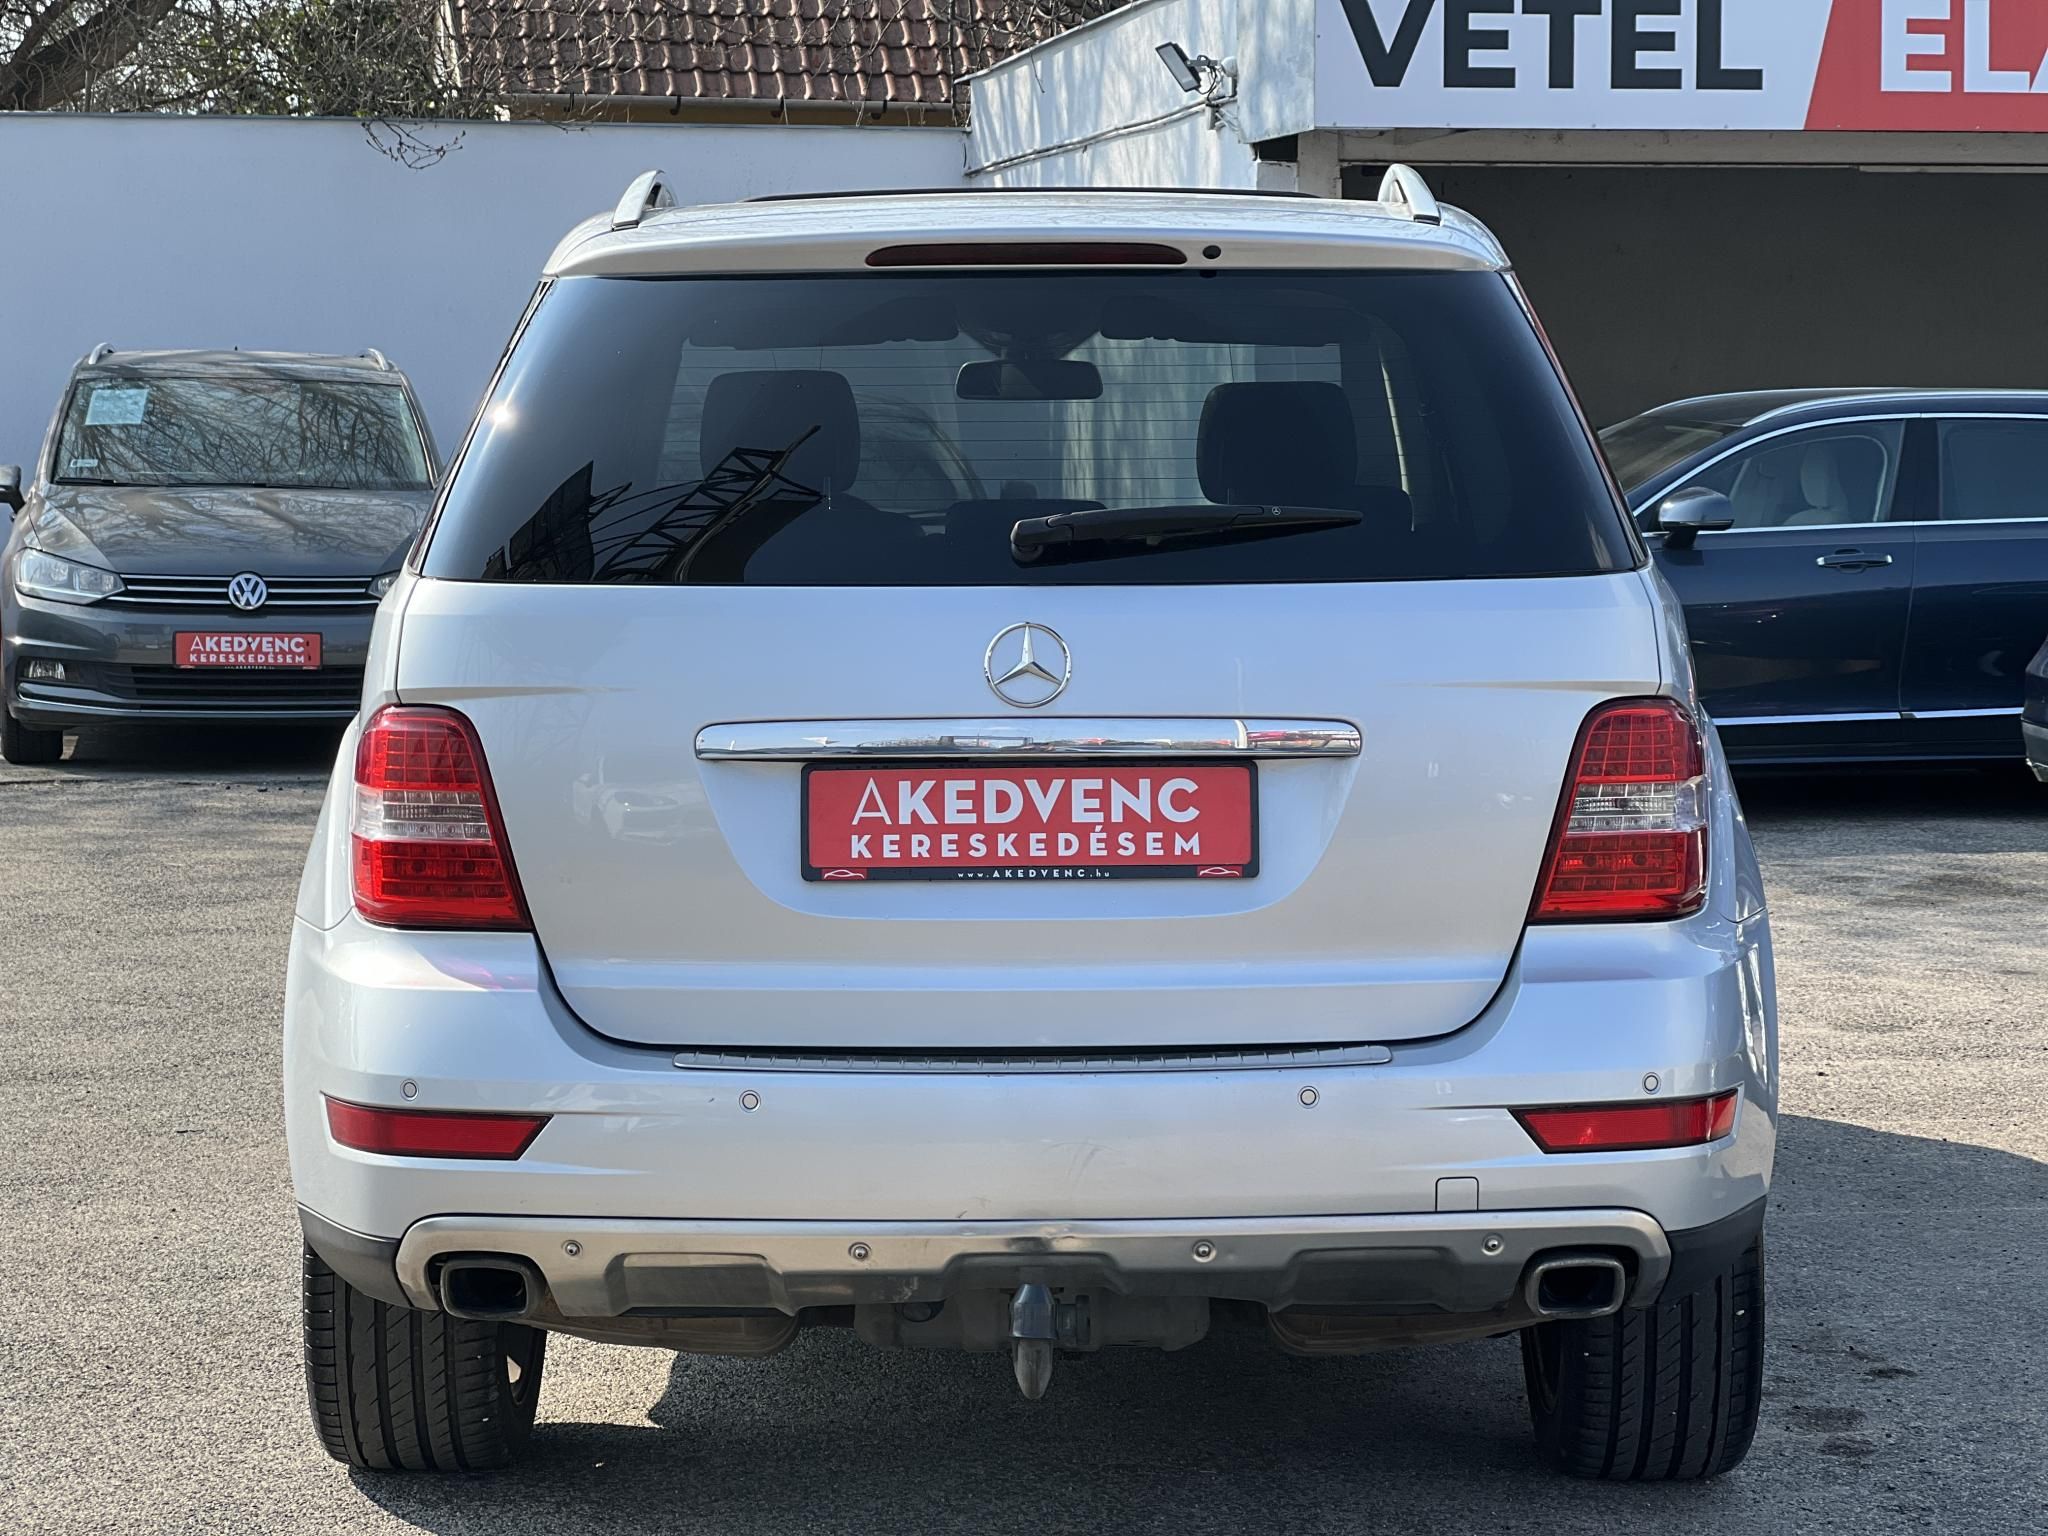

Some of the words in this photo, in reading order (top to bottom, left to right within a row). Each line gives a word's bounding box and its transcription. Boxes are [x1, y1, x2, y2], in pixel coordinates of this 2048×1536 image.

[1881, 0, 2048, 93] EL
[189, 651, 305, 663] KERESKEDÉSEM
[850, 827, 1201, 859] KERESKEDÉSEM
[957, 868, 1110, 878] www.AKEDVENC.hu
